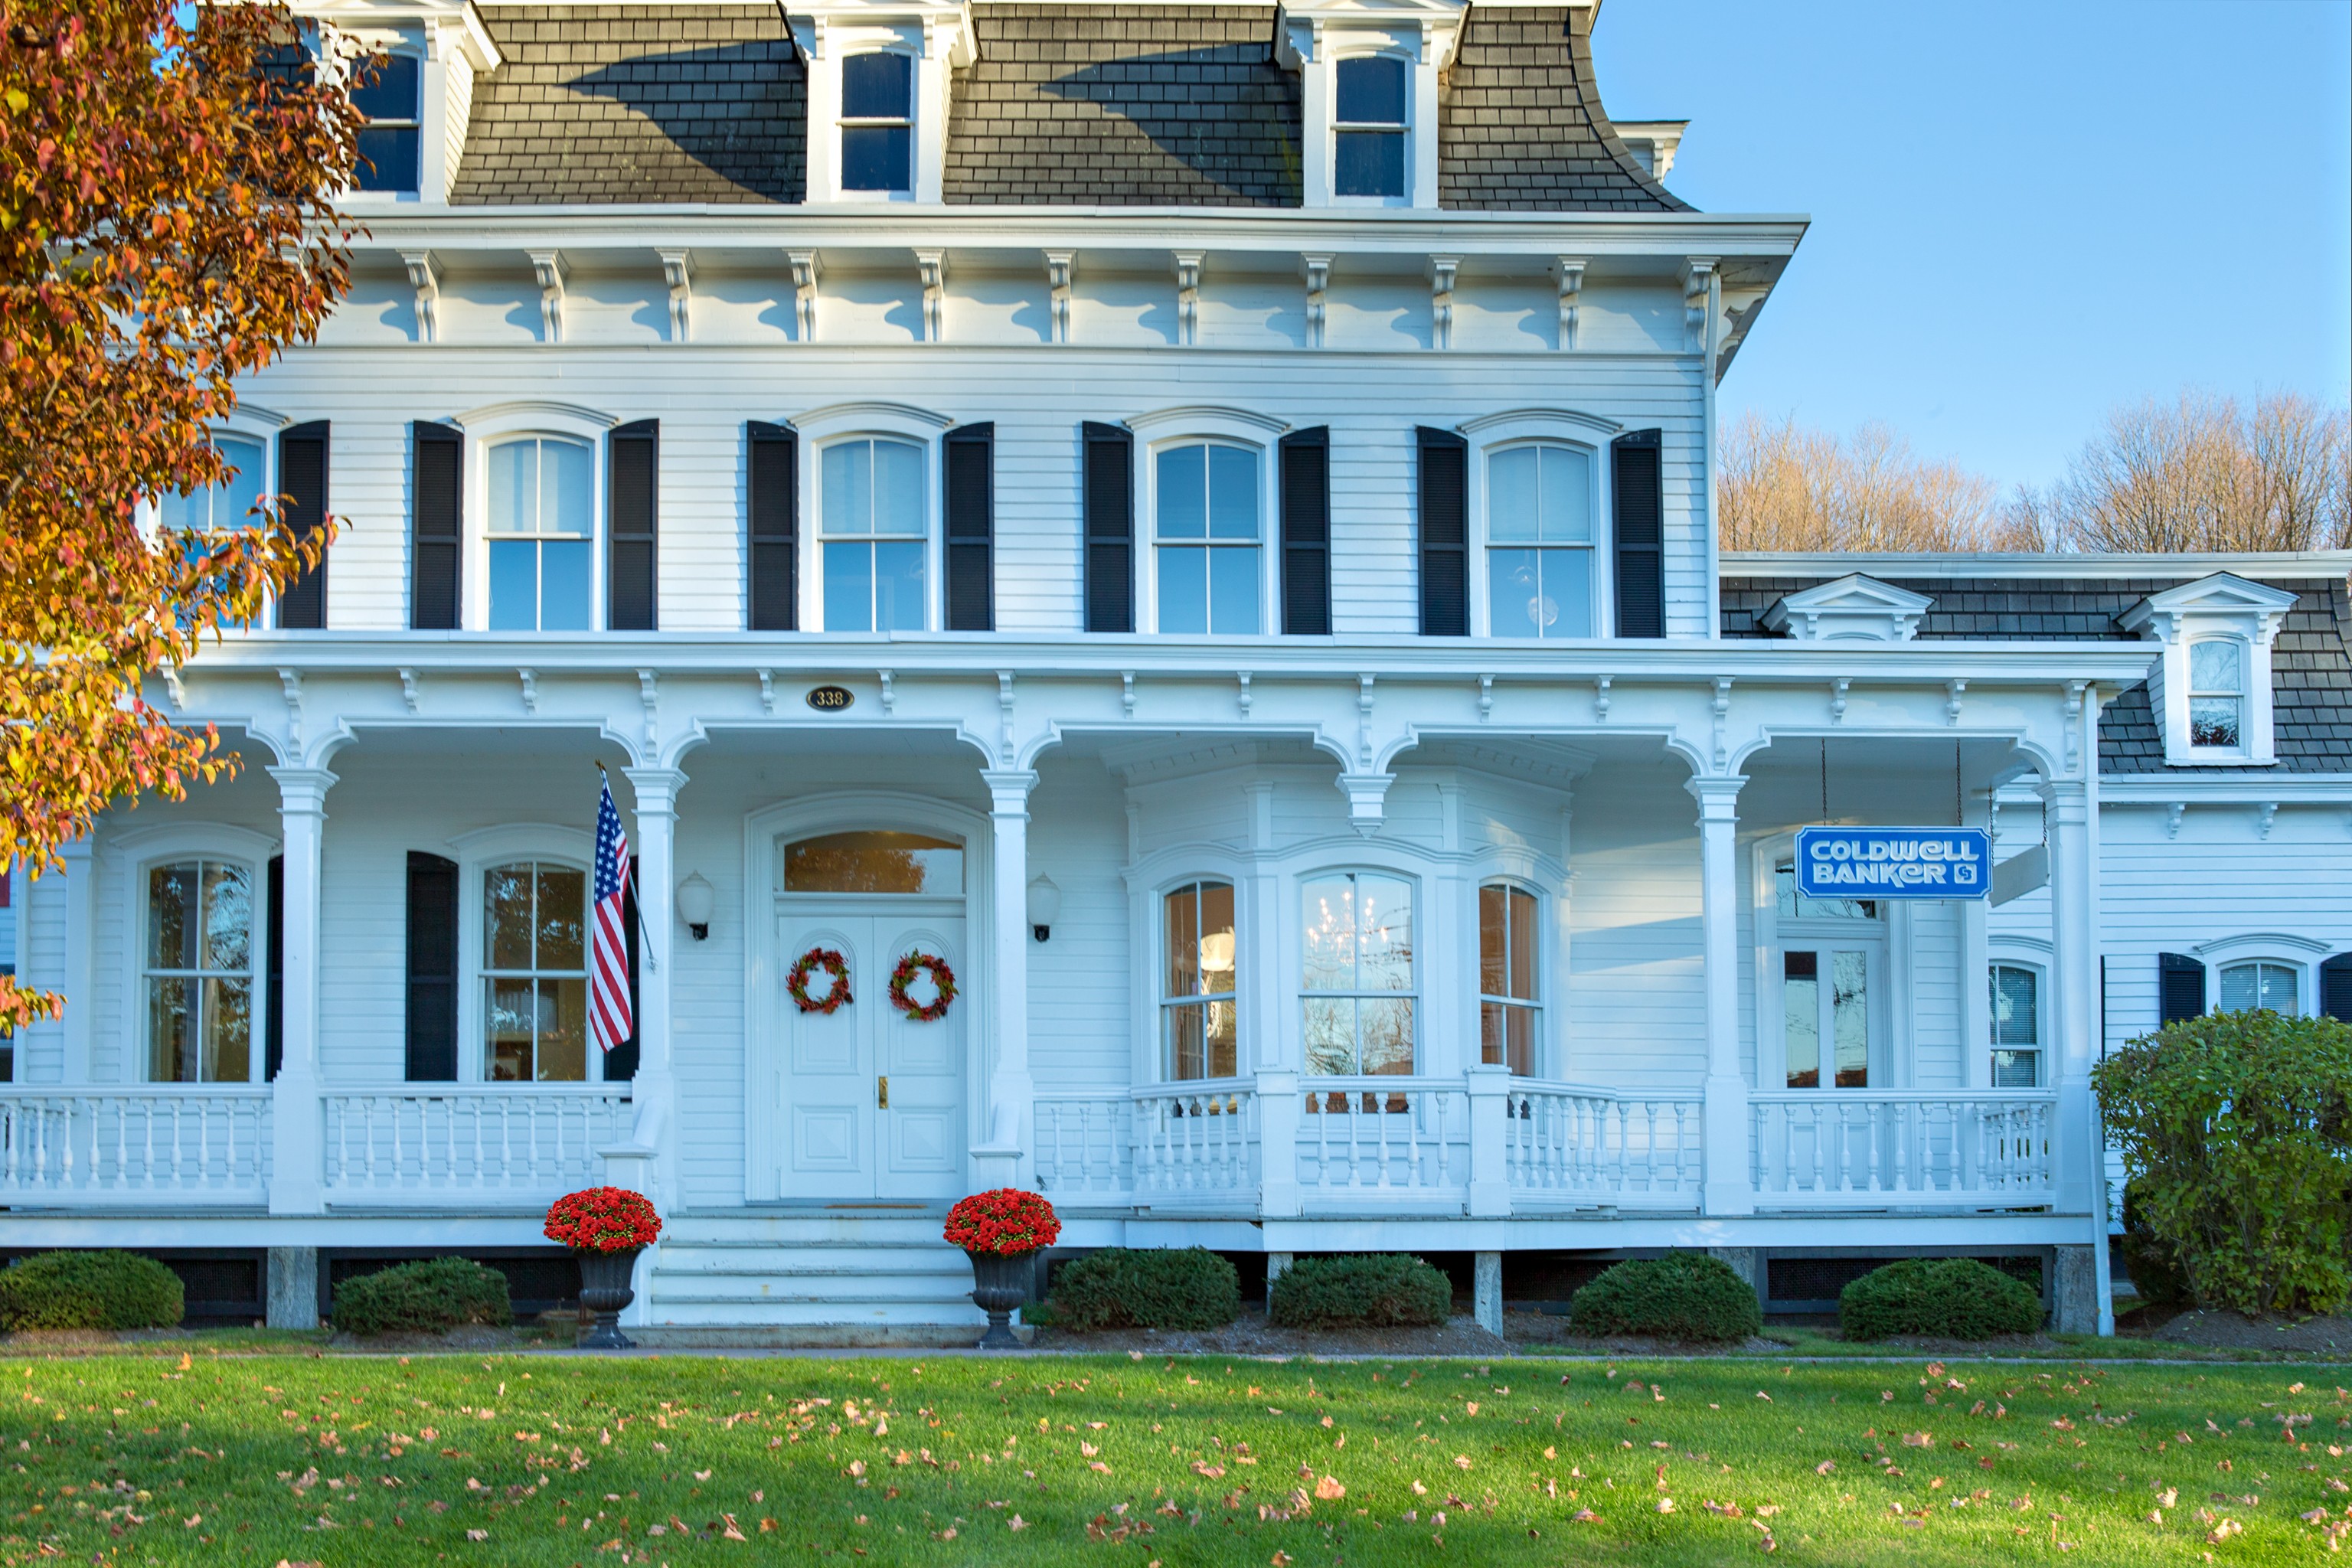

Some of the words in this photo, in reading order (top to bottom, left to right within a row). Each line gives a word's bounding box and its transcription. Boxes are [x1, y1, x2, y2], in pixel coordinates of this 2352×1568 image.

[816, 691, 844, 707] 338
[1810, 840, 1980, 861] COLDWELL
[1812, 863, 1946, 888] BANKER
